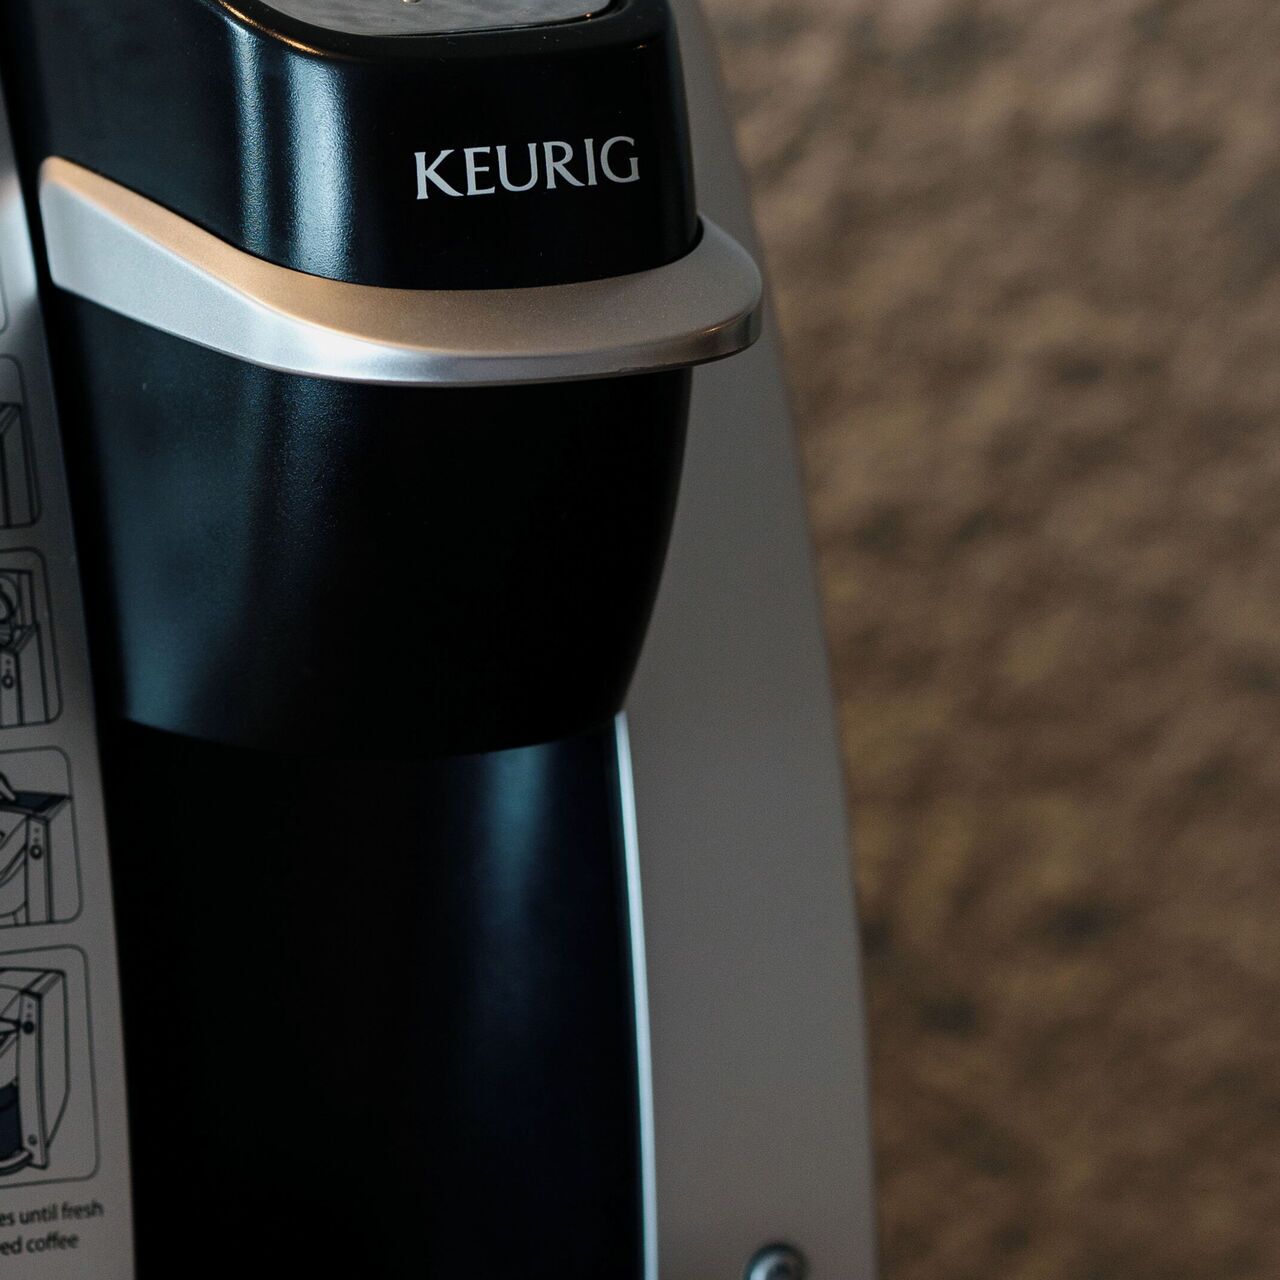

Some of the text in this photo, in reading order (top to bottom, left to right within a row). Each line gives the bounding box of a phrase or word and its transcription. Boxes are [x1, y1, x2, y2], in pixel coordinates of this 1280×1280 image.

[414, 135, 641, 200] KEURIG
[20, 1203, 58, 1224] until
[61, 1199, 105, 1219] fresh
[25, 1230, 79, 1254] coffee
